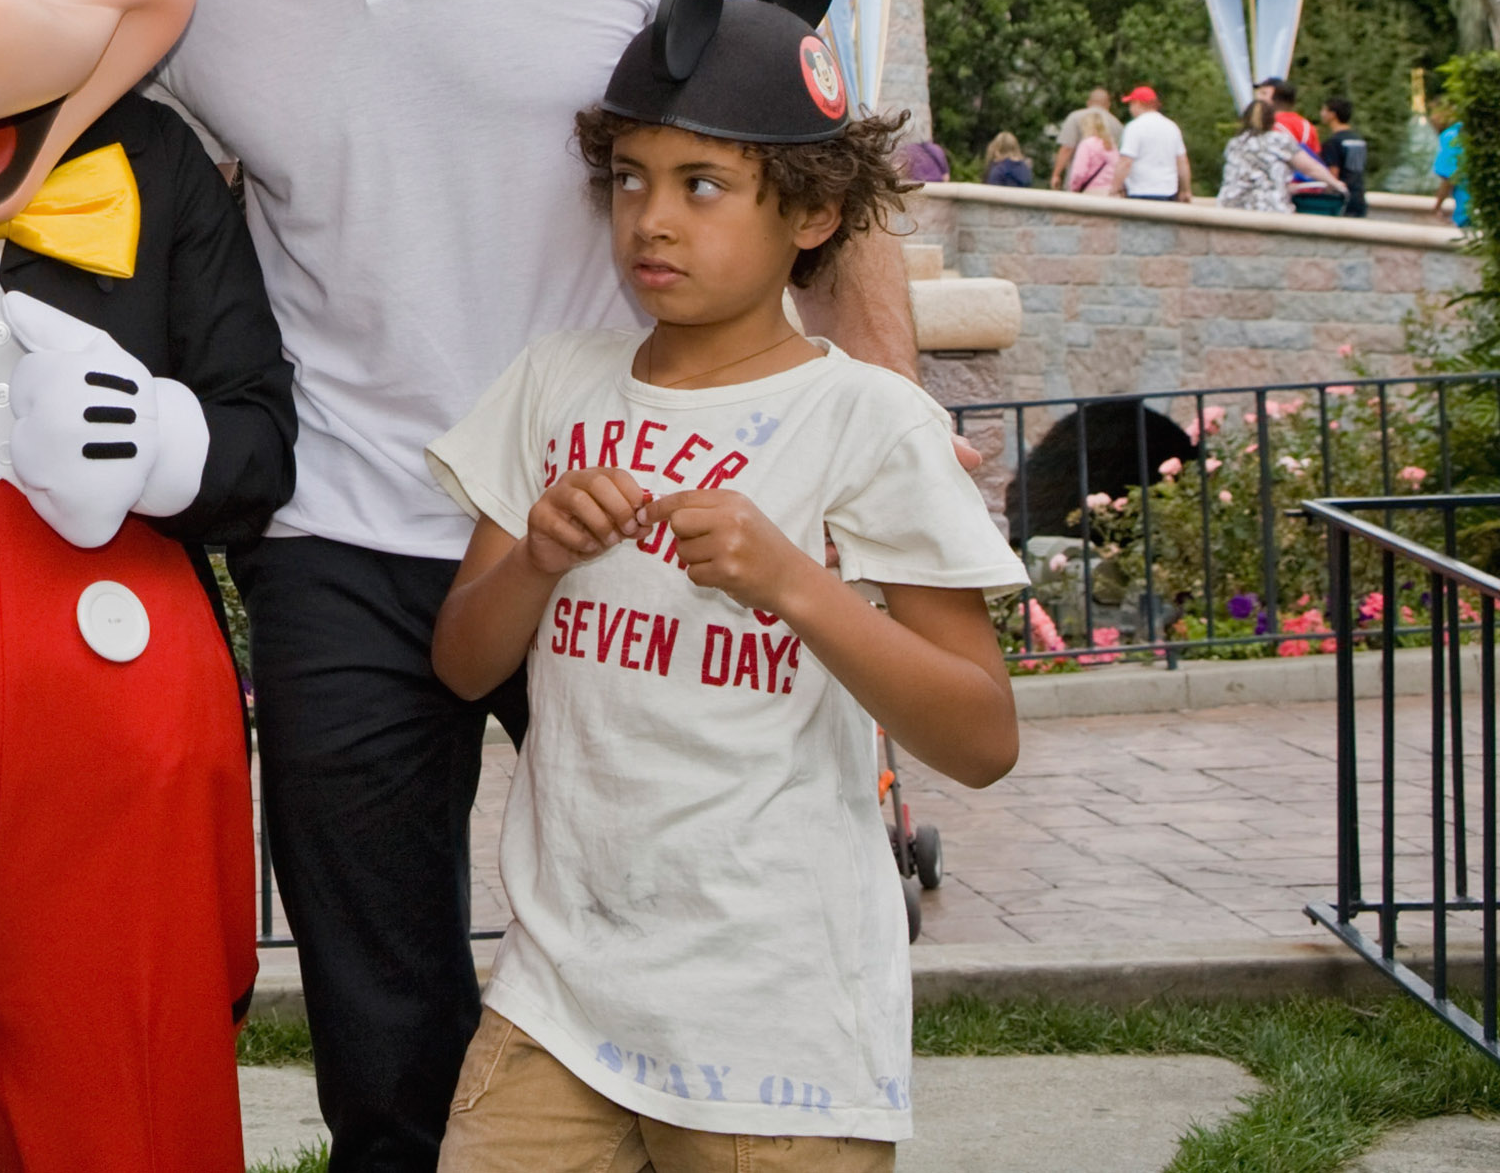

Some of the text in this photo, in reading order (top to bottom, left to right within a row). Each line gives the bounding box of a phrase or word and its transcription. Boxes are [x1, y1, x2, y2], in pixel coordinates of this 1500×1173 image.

[544, 419, 749, 490] CAREER
[551, 597, 680, 677] SEVEN
[596, 1041, 732, 1101] STAY
[759, 1075, 833, 1118] OR
